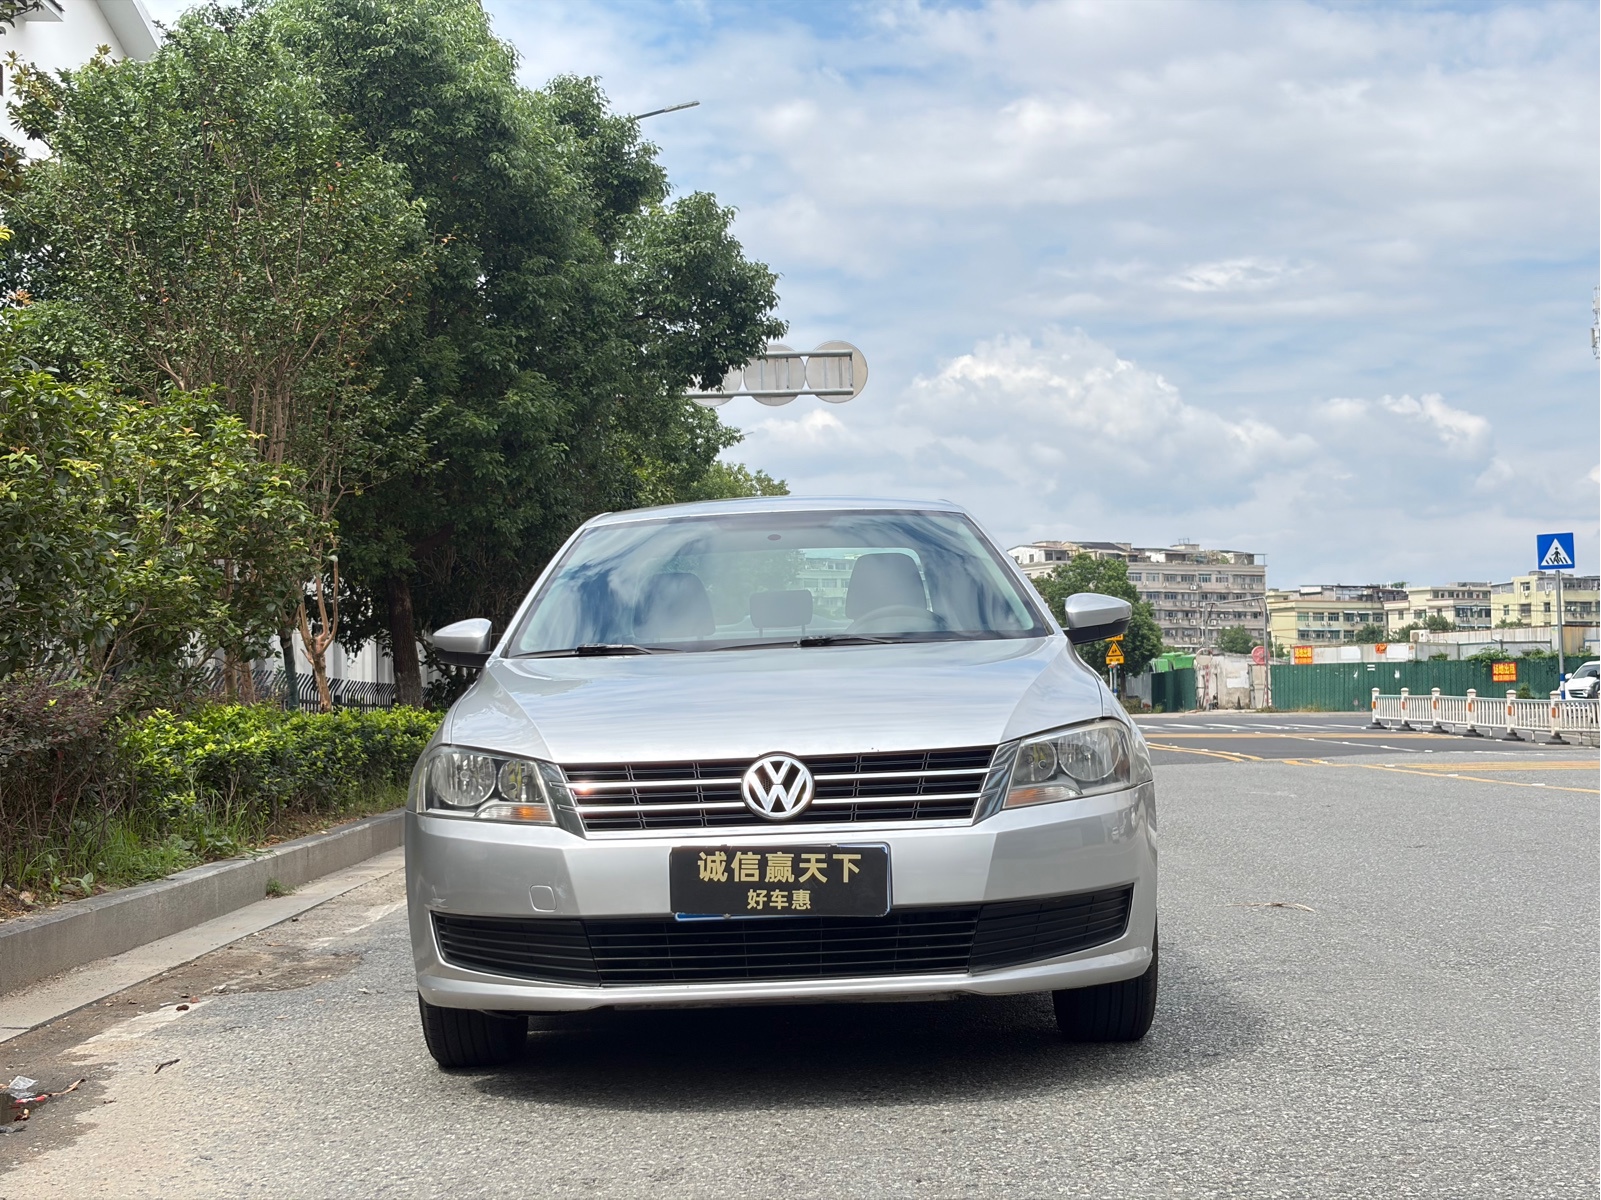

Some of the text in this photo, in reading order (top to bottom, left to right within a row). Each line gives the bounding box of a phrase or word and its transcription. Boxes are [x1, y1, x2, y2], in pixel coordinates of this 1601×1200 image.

[697, 851, 862, 883] 诚信赢天下
[747, 888, 812, 910] 好车惠
